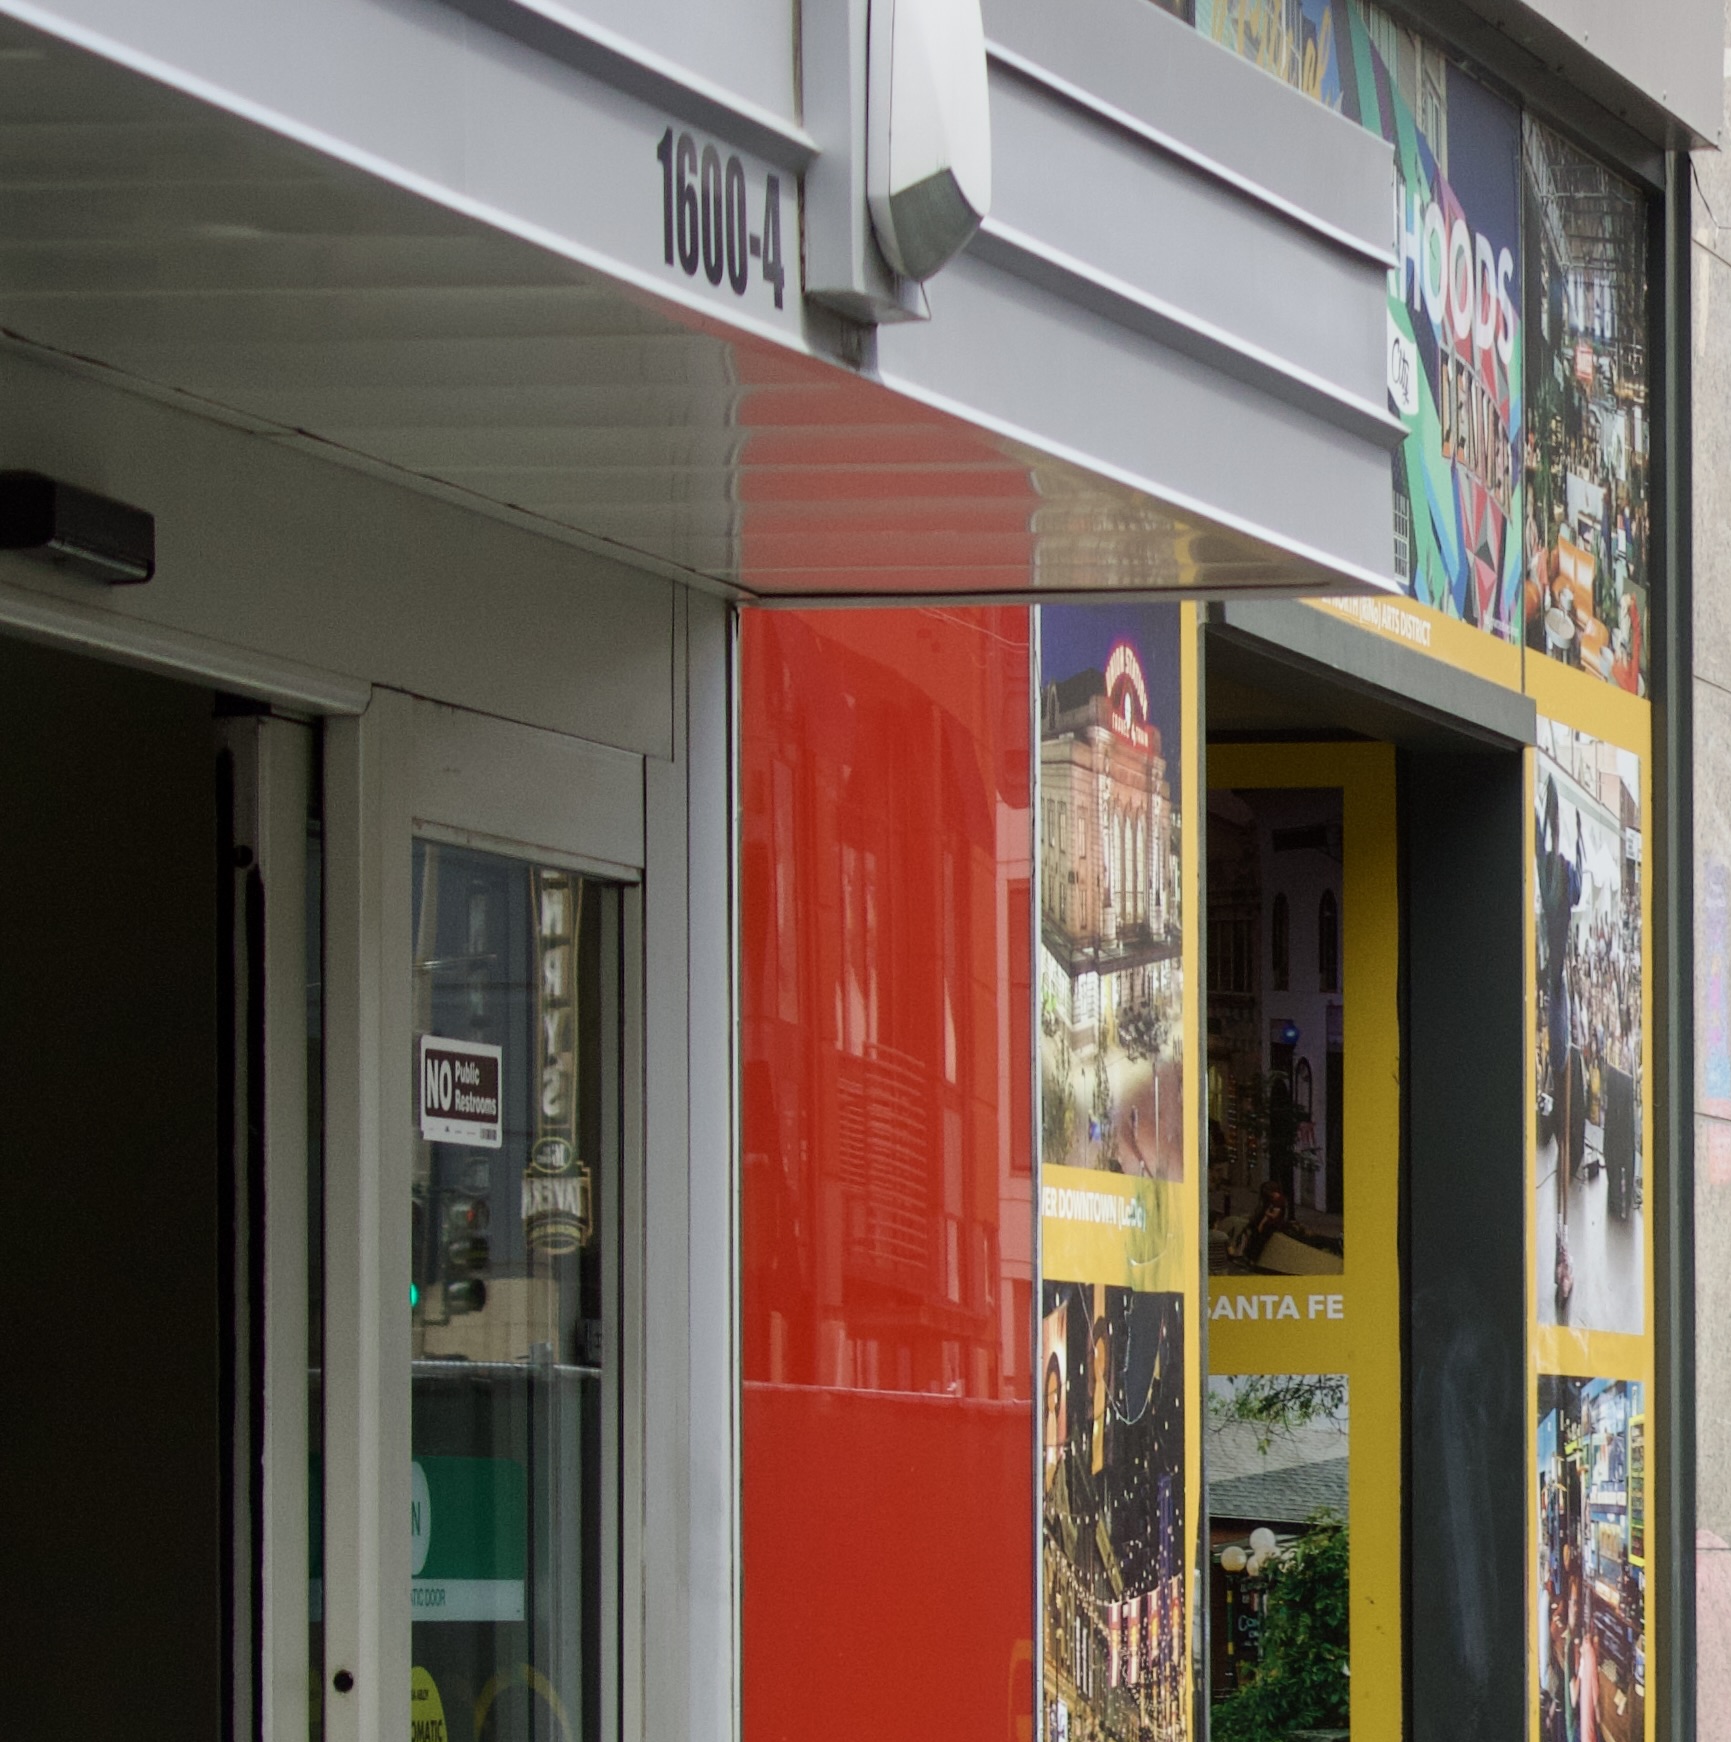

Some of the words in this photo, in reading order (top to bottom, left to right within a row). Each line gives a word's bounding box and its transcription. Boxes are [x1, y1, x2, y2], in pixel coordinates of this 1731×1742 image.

[657, 126, 785, 310] 1600-4
[1400, 613, 1432, 648] DISTRICT
[426, 1059, 453, 1112] NO
[455, 1060, 480, 1086] Public
[455, 1088, 497, 1117] Restrooms
[1059, 1188, 1117, 1225] DOWNTOWN
[1207, 1294, 1301, 1321] ANTA
[1308, 1294, 1345, 1320] FE
